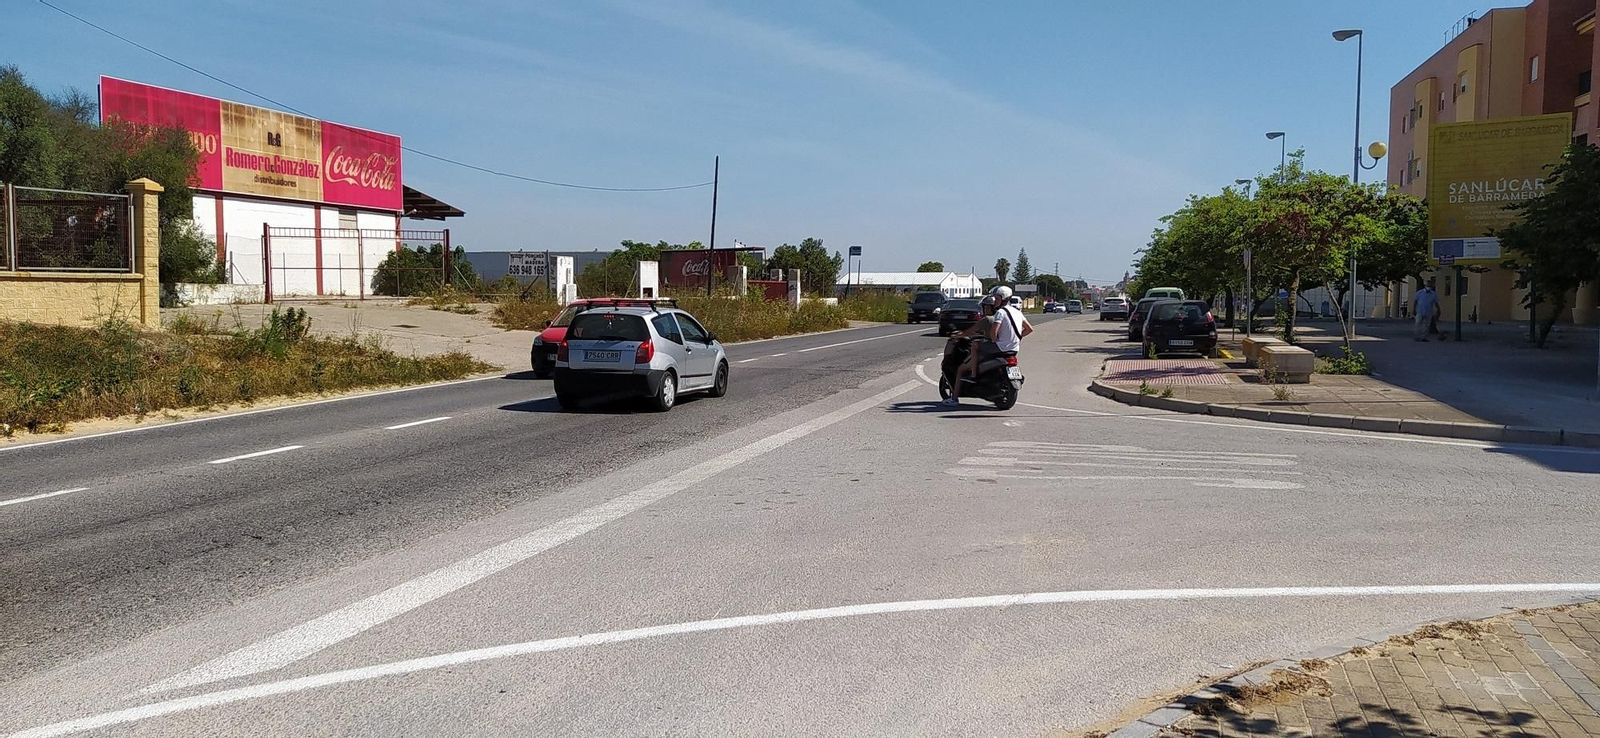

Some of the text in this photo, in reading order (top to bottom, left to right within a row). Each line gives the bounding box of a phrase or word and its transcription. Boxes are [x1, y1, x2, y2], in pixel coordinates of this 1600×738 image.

[225, 146, 271, 173] Romero
[274, 154, 320, 179] González
[253, 174, 297, 188] distribuidores
[1449, 177, 1546, 195] SANLÚCAR
[1449, 191, 1546, 204] DE BARRAMEDA
[509, 264, 545, 275] 636 948 165
